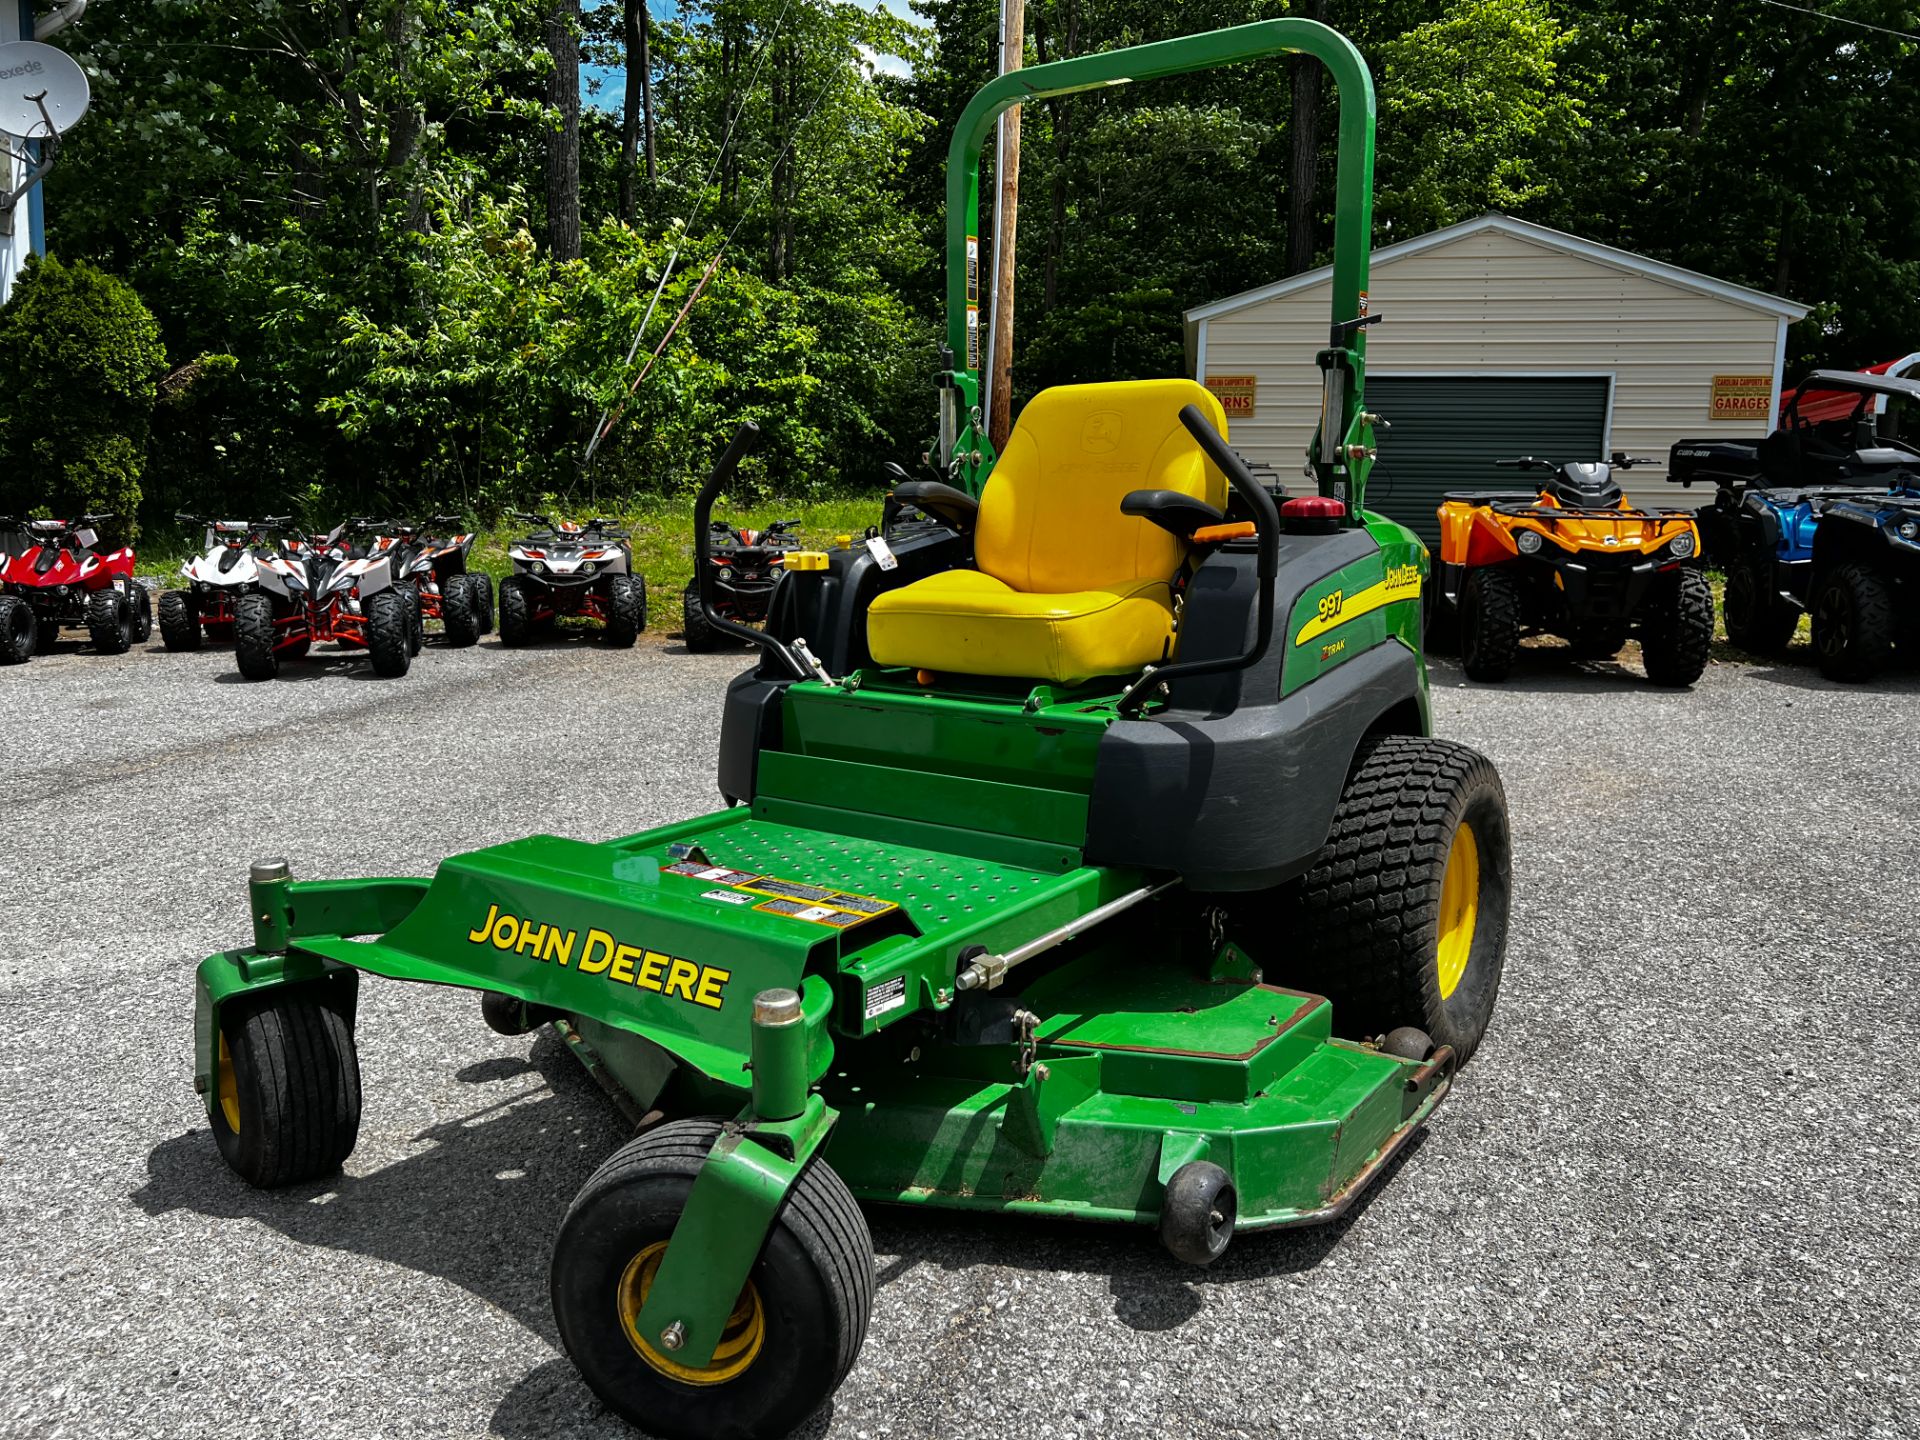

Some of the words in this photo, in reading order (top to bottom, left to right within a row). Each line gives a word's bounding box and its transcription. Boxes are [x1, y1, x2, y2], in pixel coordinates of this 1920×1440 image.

[0, 60, 43, 80] exede
[1715, 398, 1769, 409] GARAGES
[1385, 566, 1402, 590] JOHN
[1401, 563, 1418, 586] DEERE
[1318, 589, 1343, 622] 997
[467, 903, 577, 967] JOHN
[577, 927, 731, 1011] DEERE
